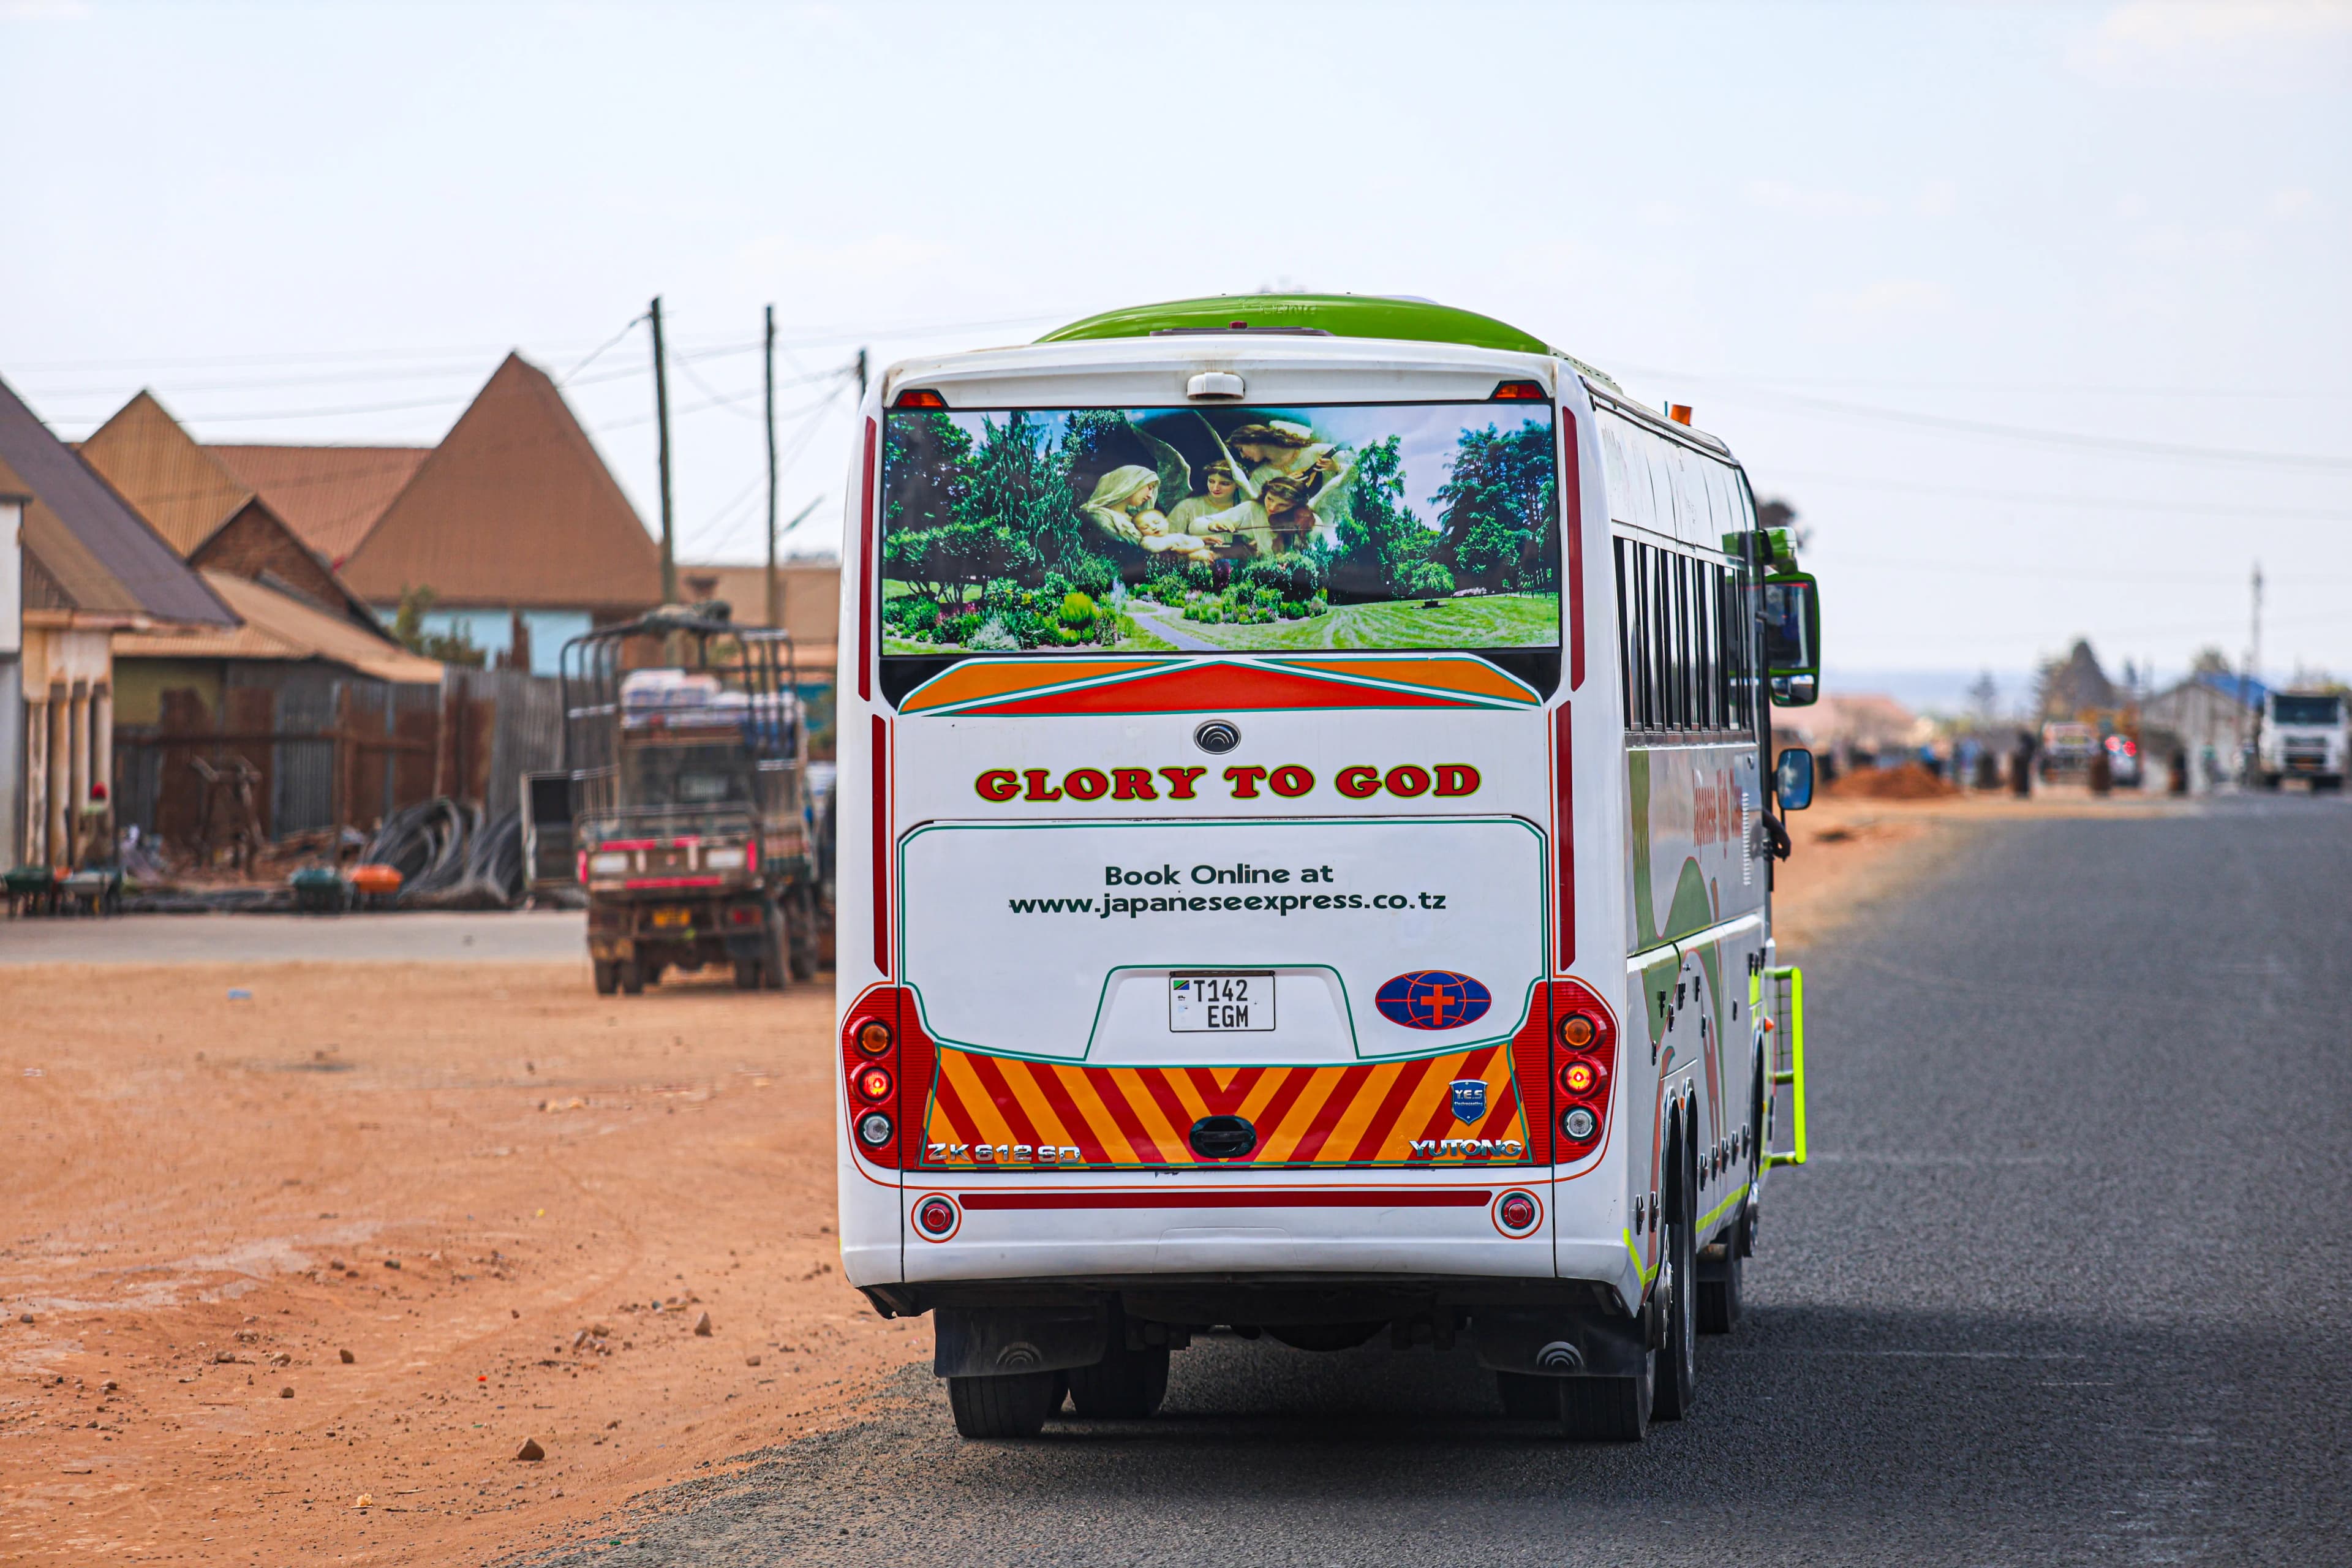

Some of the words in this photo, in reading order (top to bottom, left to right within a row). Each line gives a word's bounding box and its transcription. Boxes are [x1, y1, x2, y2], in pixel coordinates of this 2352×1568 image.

[975, 766, 1208, 802] GLORY
[1223, 764, 1315, 799] TO
[1334, 763, 1481, 799] GOD
[1106, 864, 1182, 886] Book
[1191, 863, 1291, 884] Online
[1300, 865, 1334, 883] at
[1009, 892, 1447, 919] www.japaneseexpress.co.tz
[1194, 979, 1248, 1002] T142
[1208, 1005, 1248, 1028] EGM
[927, 1142, 1081, 1163] ZK6126D
[1409, 1139, 1523, 1157] YUTONG
